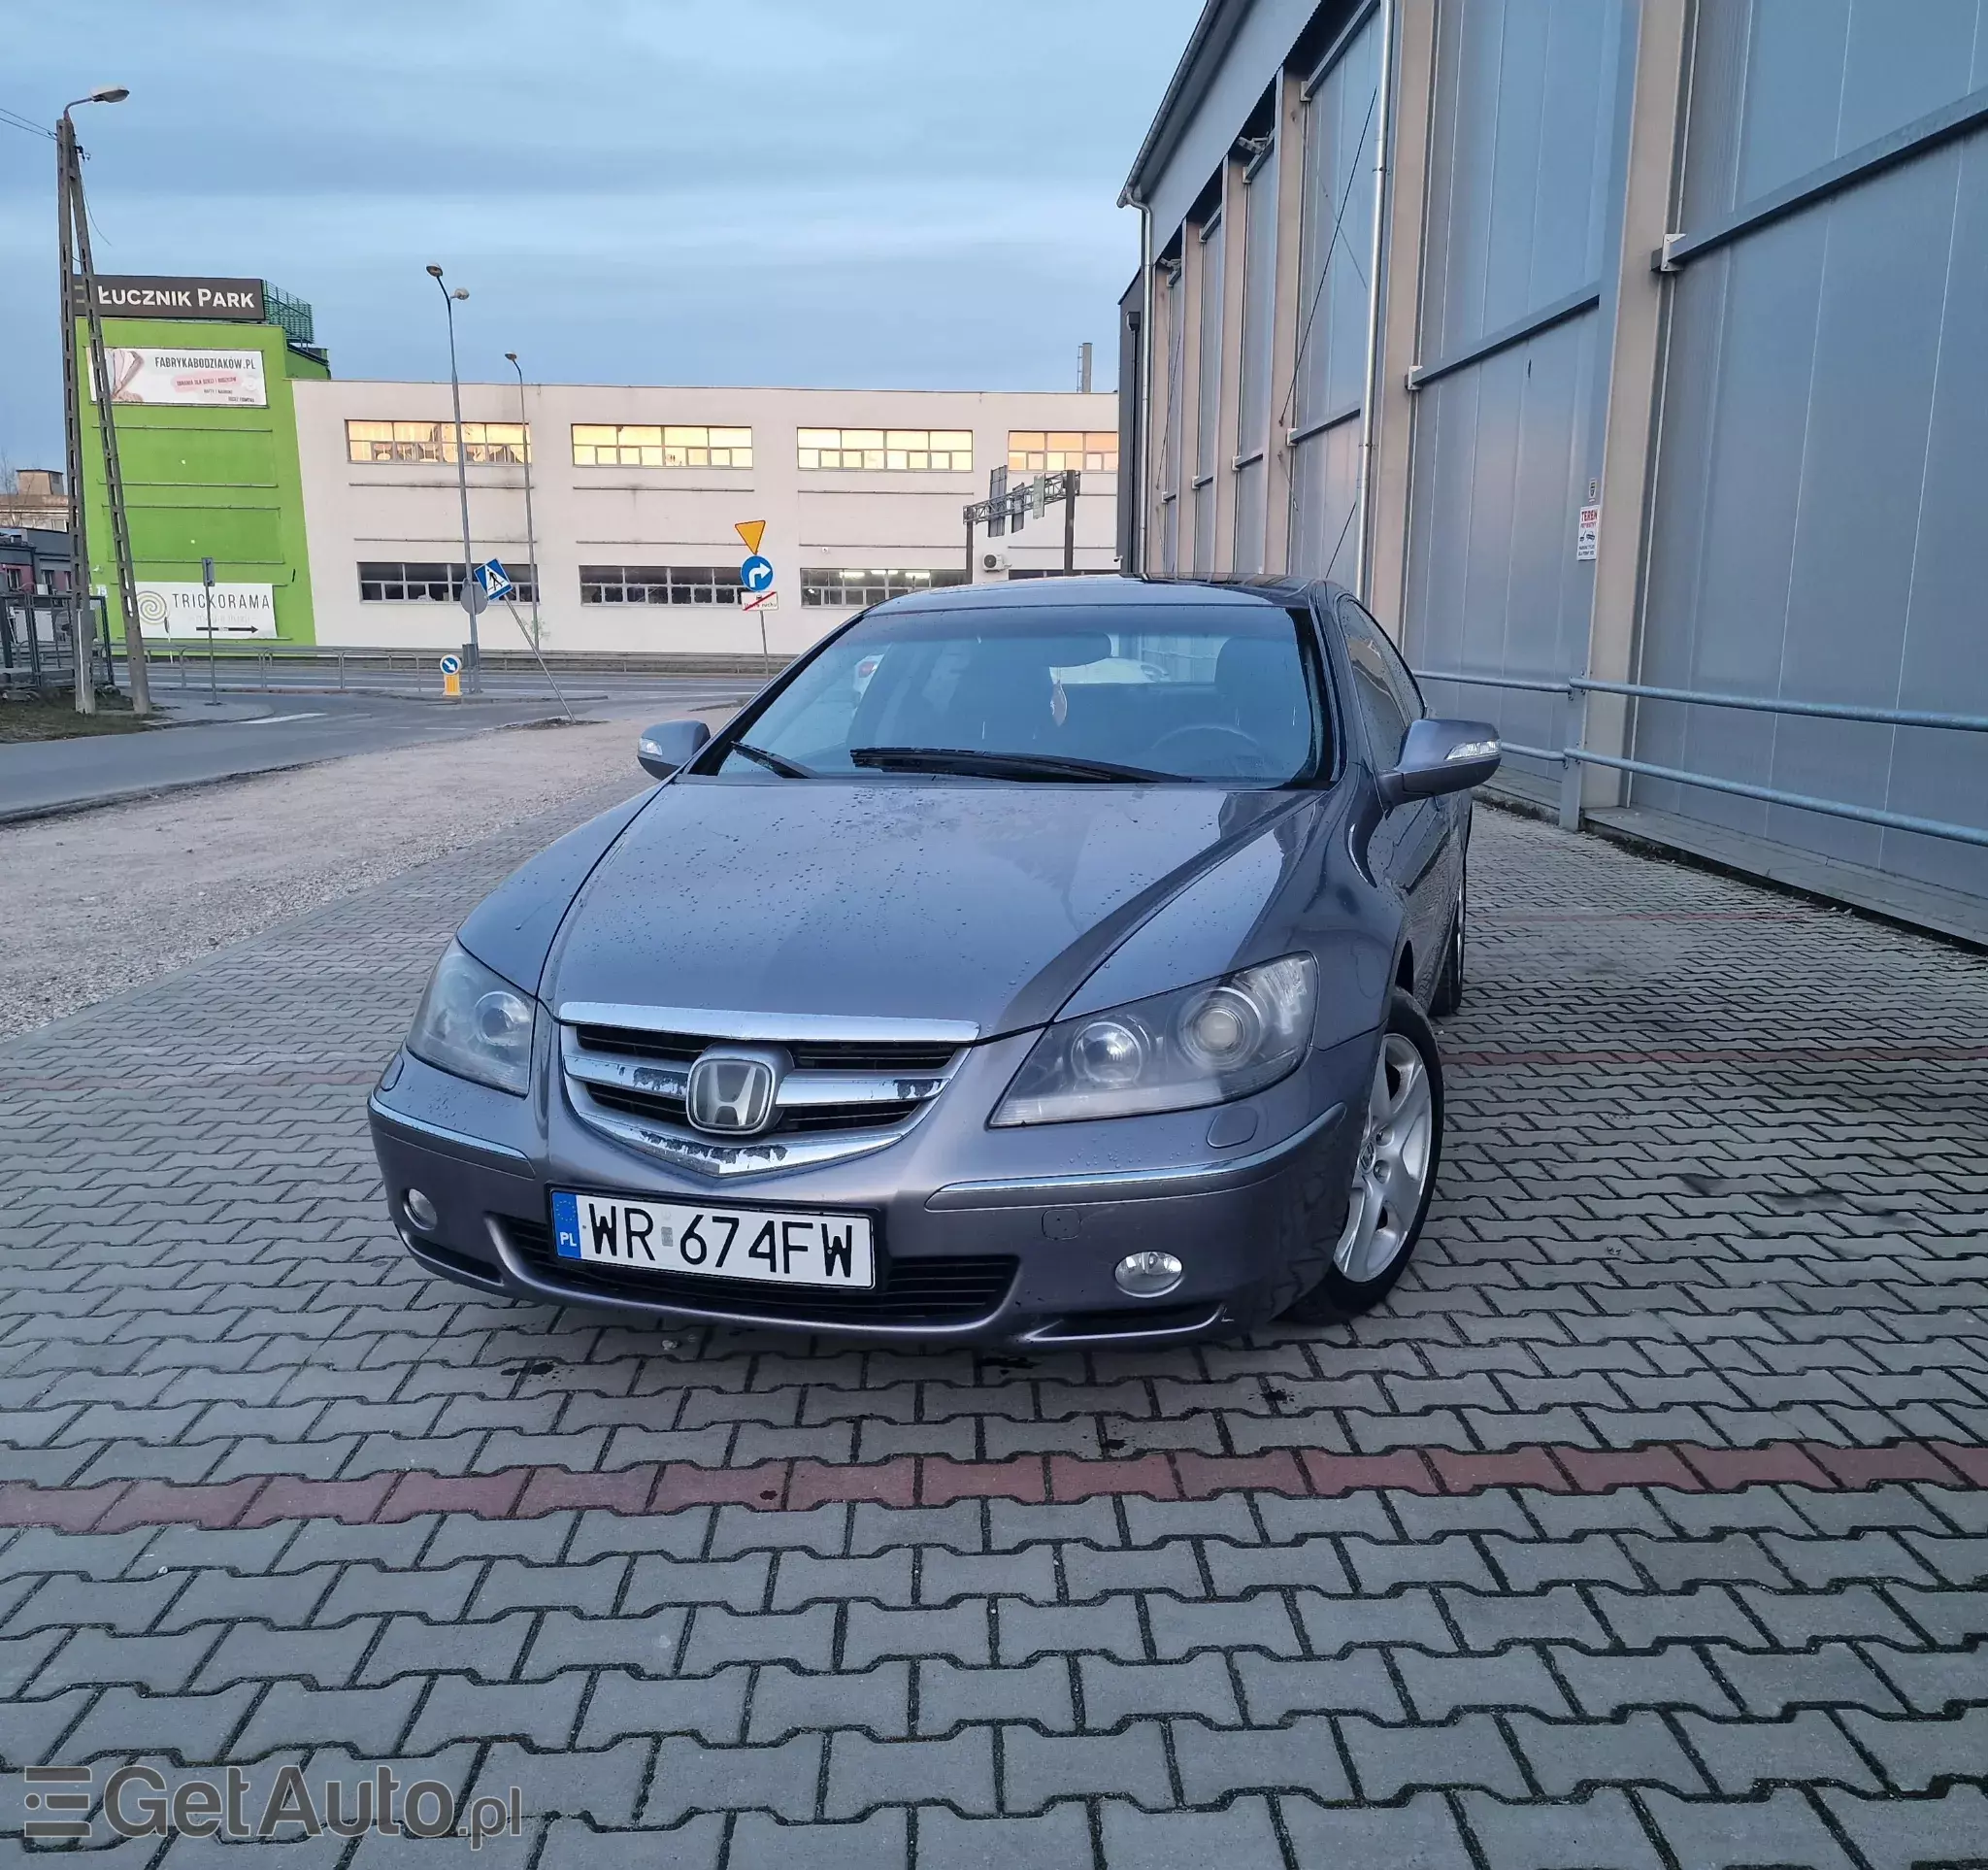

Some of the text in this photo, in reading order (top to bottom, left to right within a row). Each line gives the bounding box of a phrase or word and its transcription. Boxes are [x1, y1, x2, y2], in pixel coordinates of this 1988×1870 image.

[97, 285, 255, 309] ŁUCZNIK PARK
[154, 355, 256, 370] FABRYKABODZIAKÓW.PL
[1581, 510, 1598, 521] TEREN
[172, 593, 271, 609] TRICKORAMA
[560, 1231, 578, 1248] PL
[588, 1203, 853, 1279] WR 674FW
